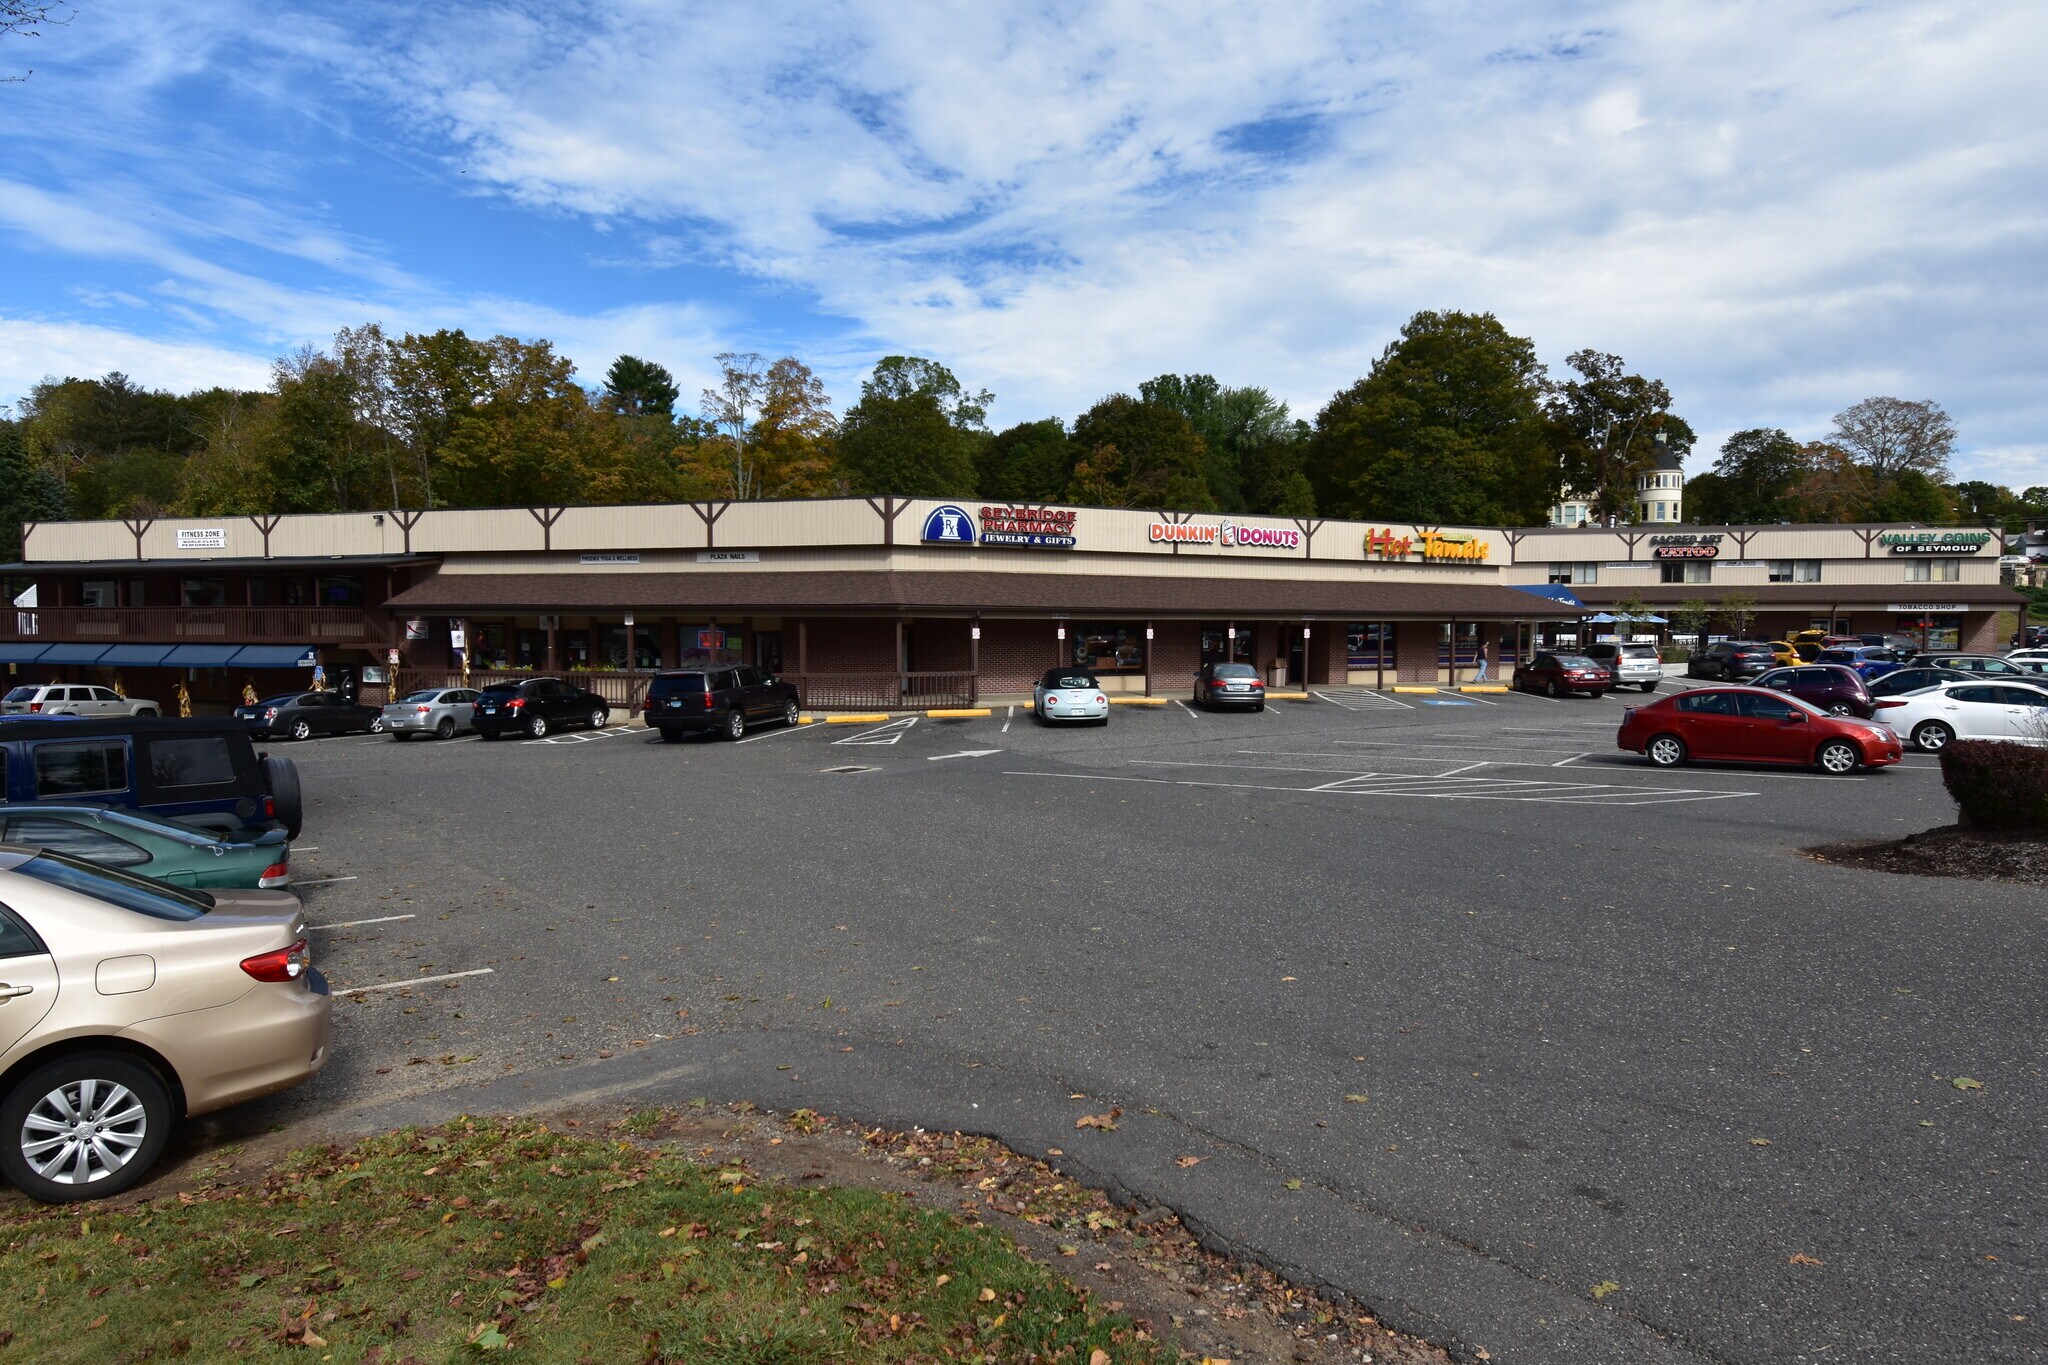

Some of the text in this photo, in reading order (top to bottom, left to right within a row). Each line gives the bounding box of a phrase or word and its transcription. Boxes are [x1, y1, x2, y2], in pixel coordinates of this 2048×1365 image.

[981, 506, 1077, 522] SEYBRIDGE
[983, 519, 1075, 535] PHARMACY
[985, 534, 1030, 543] JEWELRY
[1045, 537, 1073, 545] GIFTS
[1151, 523, 1300, 546] DUNKIN' DONUTS
[1650, 534, 1724, 545] SACRED ART
[1881, 532, 1991, 544] VALLEY COINS
[1367, 527, 1489, 559] Hot Tamale
[1659, 547, 1716, 557] TATTOO
